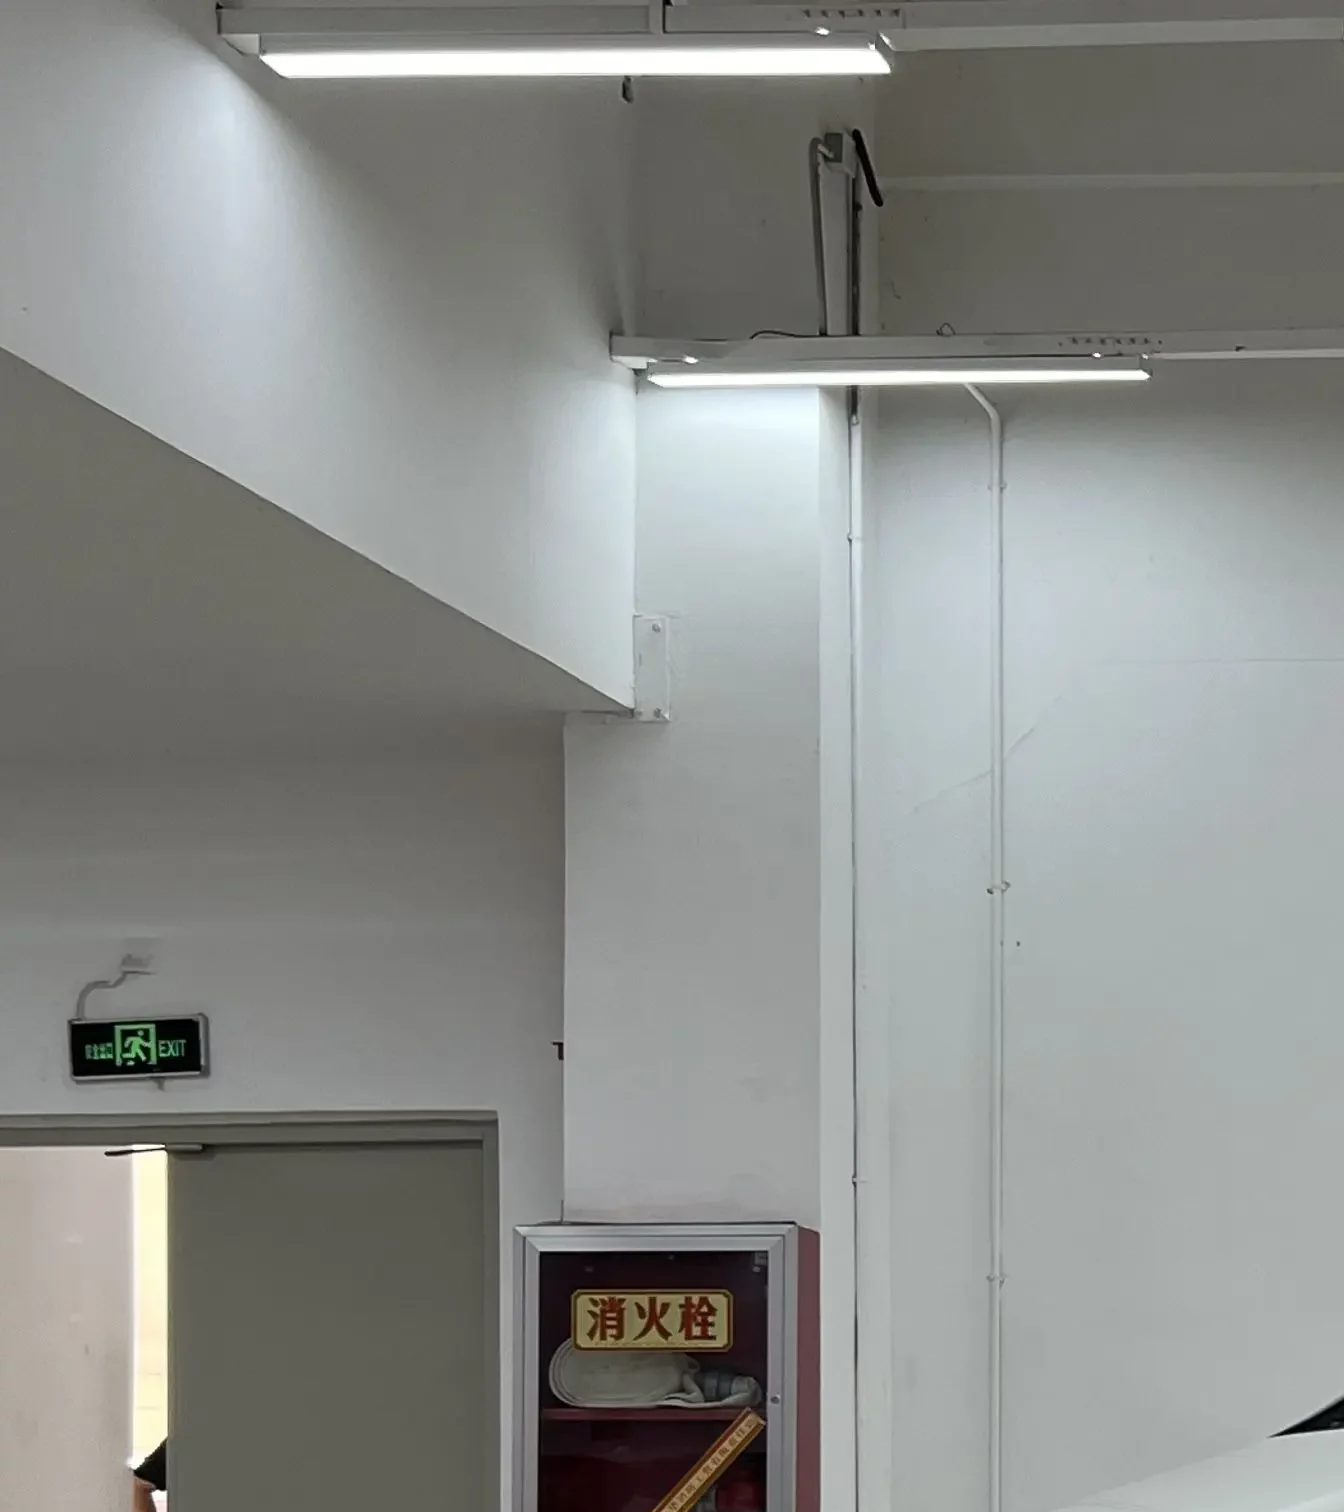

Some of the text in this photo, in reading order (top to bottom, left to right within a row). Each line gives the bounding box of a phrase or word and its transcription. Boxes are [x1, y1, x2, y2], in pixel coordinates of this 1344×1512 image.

[158, 1039, 187, 1058] EXIT
[586, 1295, 719, 1342] 消火栓
